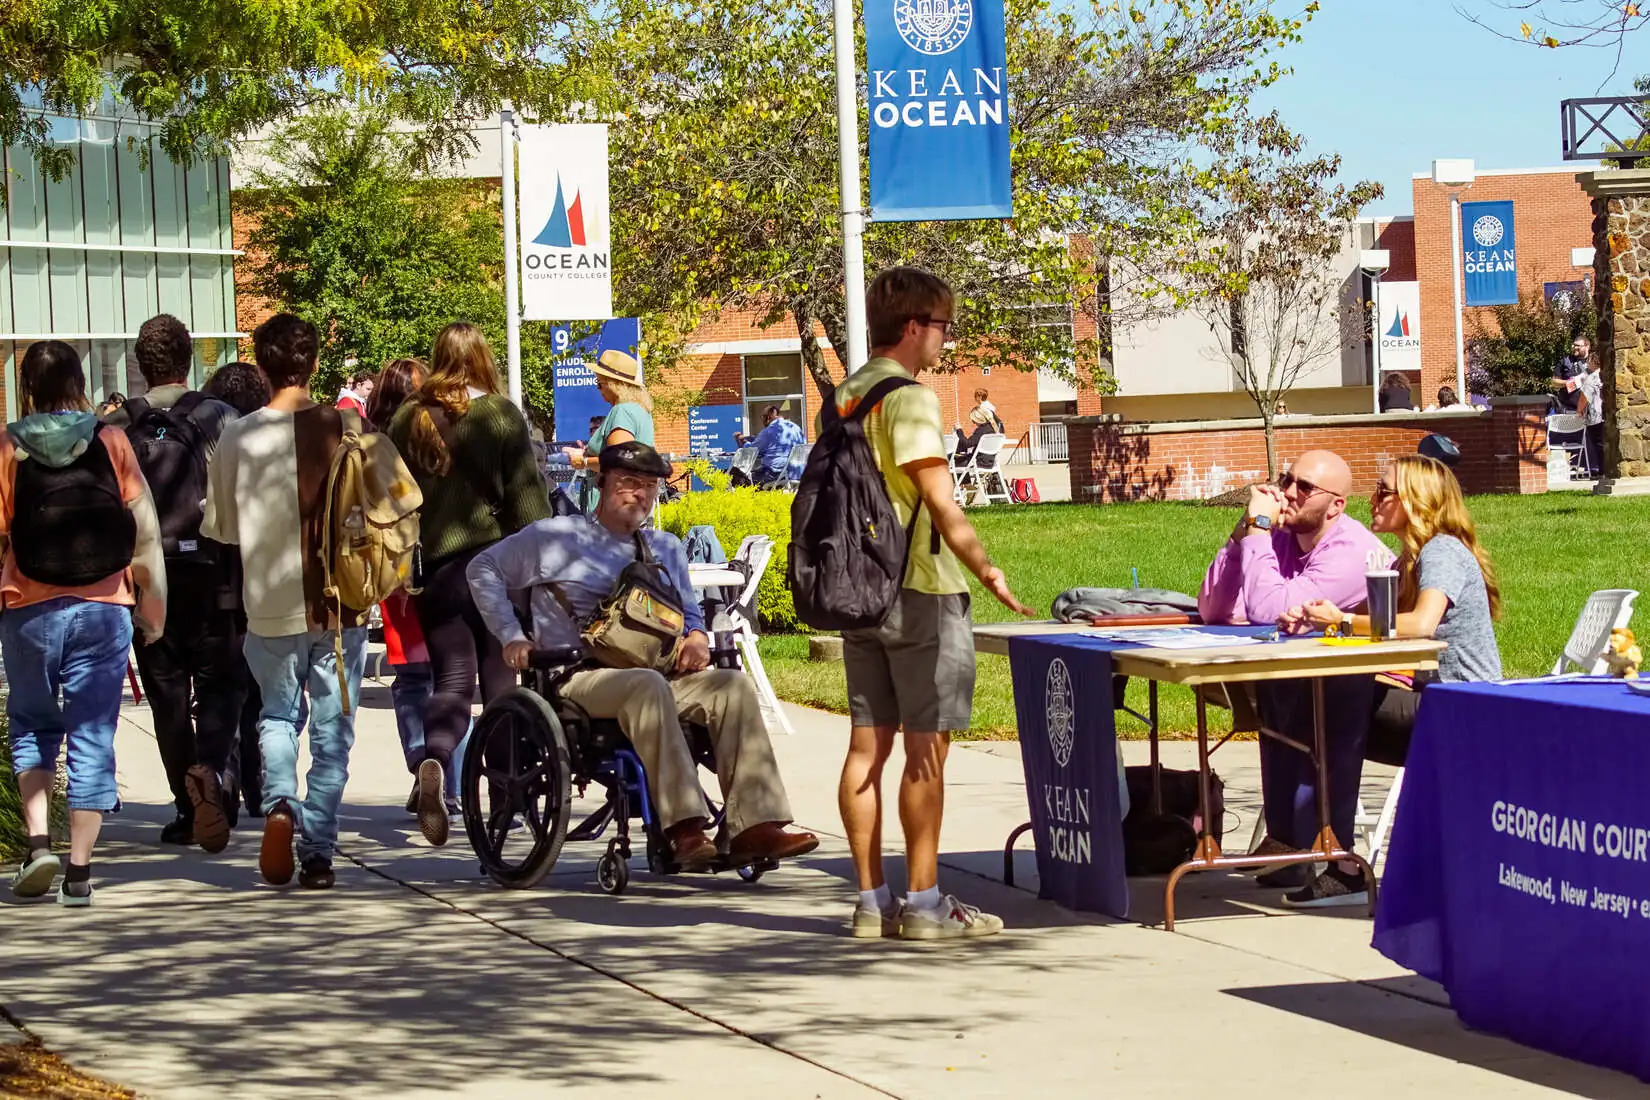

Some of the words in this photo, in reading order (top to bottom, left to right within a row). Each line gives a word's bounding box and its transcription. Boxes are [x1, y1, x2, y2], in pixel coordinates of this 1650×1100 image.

[916, 36, 953, 51] 1855
[872, 67, 1002, 98] KEAN
[873, 99, 1002, 128] OCEAN
[526, 253, 607, 269] OCEAN
[1464, 249, 1515, 262] KEAN
[1465, 261, 1515, 273] OCEAN
[555, 329, 569, 350] 9
[1382, 339, 1419, 347] OCEAN
[556, 357, 586, 366] STUDE
[556, 367, 594, 377] ENROLL
[1044, 784, 1090, 824] KEAN
[1491, 800, 1586, 853] GEORGIAN
[1593, 822, 1650, 862] COUR
[1499, 862, 1556, 904] Lakewood,
[1561, 880, 1587, 907] New
[1640, 899, 1650, 918] e
